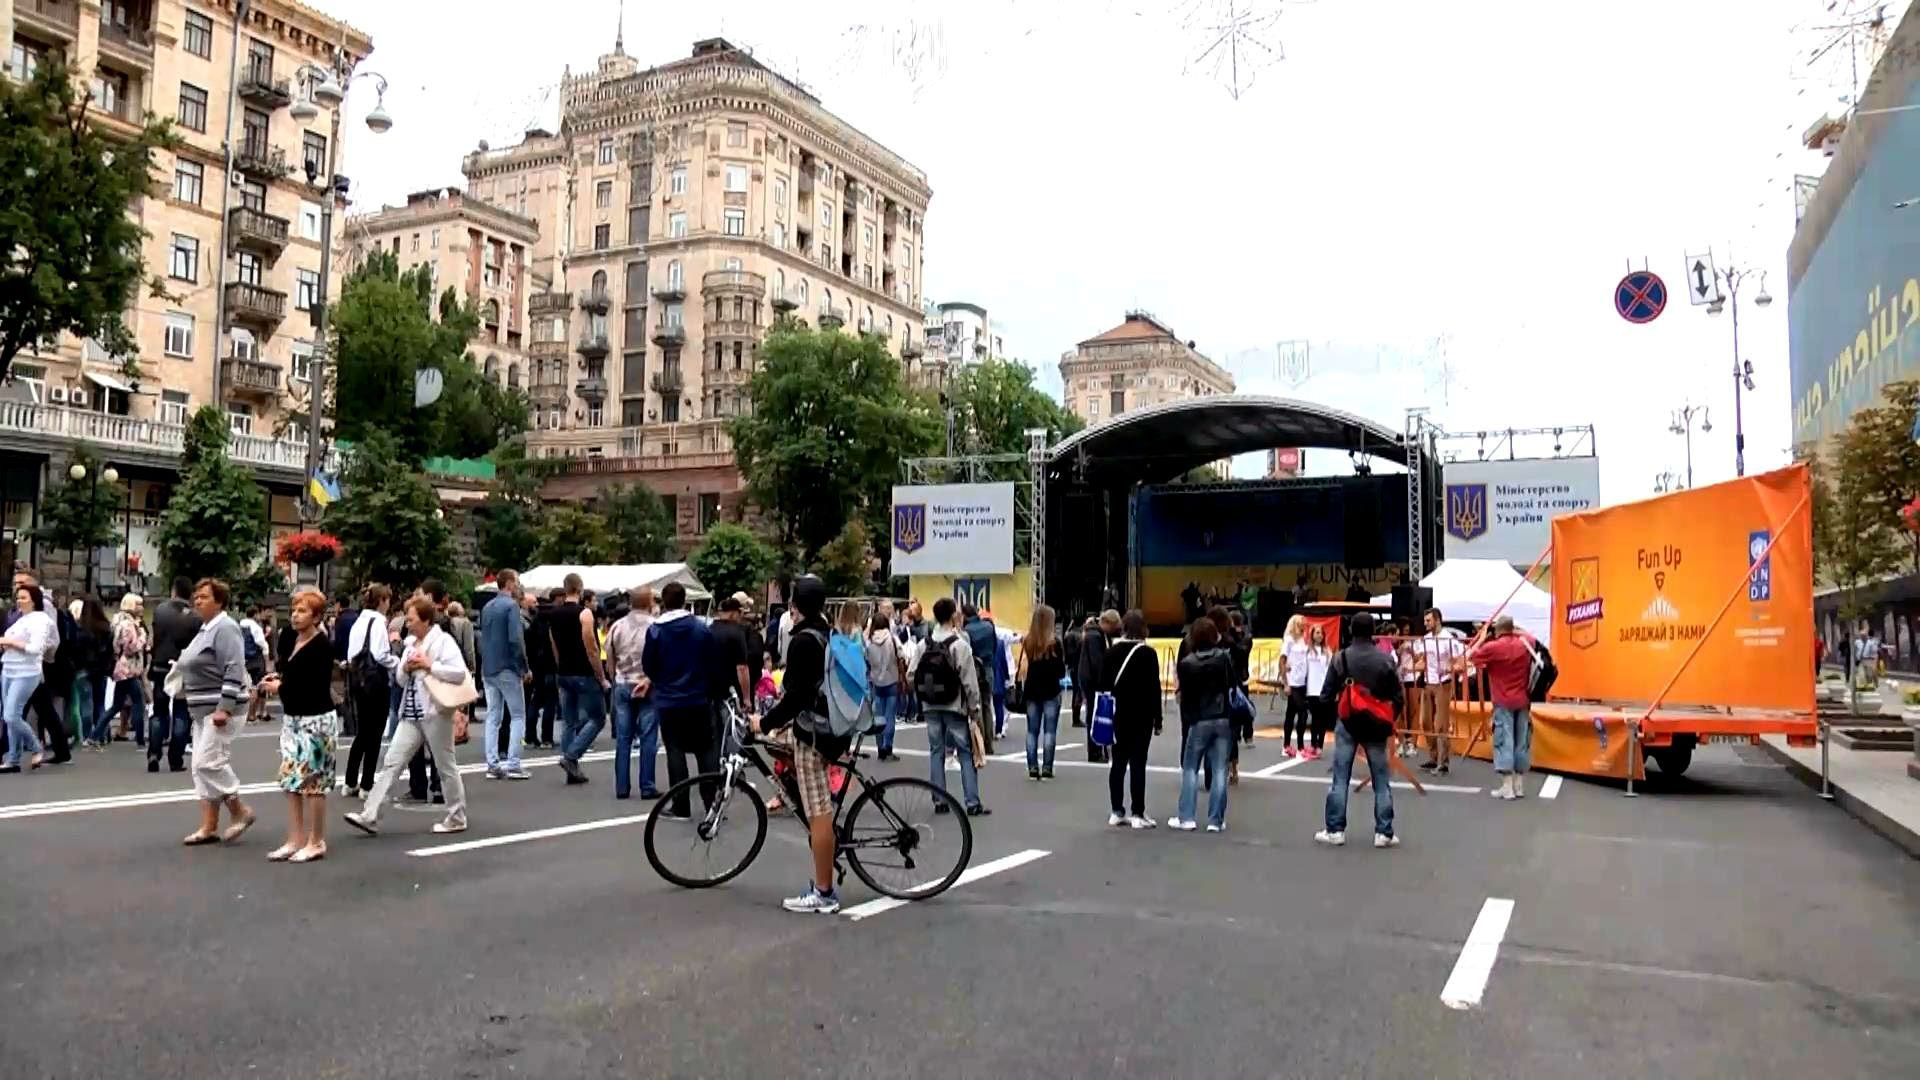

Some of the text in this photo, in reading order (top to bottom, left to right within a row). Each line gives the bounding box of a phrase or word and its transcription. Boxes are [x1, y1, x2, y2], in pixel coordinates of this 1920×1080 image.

[1496, 485, 1570, 497] Міністерство
[1496, 498, 1590, 511] молоді та спорту
[932, 506, 991, 516] Міністерство
[1496, 514, 1543, 526] України
[932, 530, 969, 540] України
[1637, 544, 1682, 571] Fun Up
[1619, 622, 1667, 642] ЗАРЯДЖАЙ
[1678, 624, 1706, 641] НАМИ
